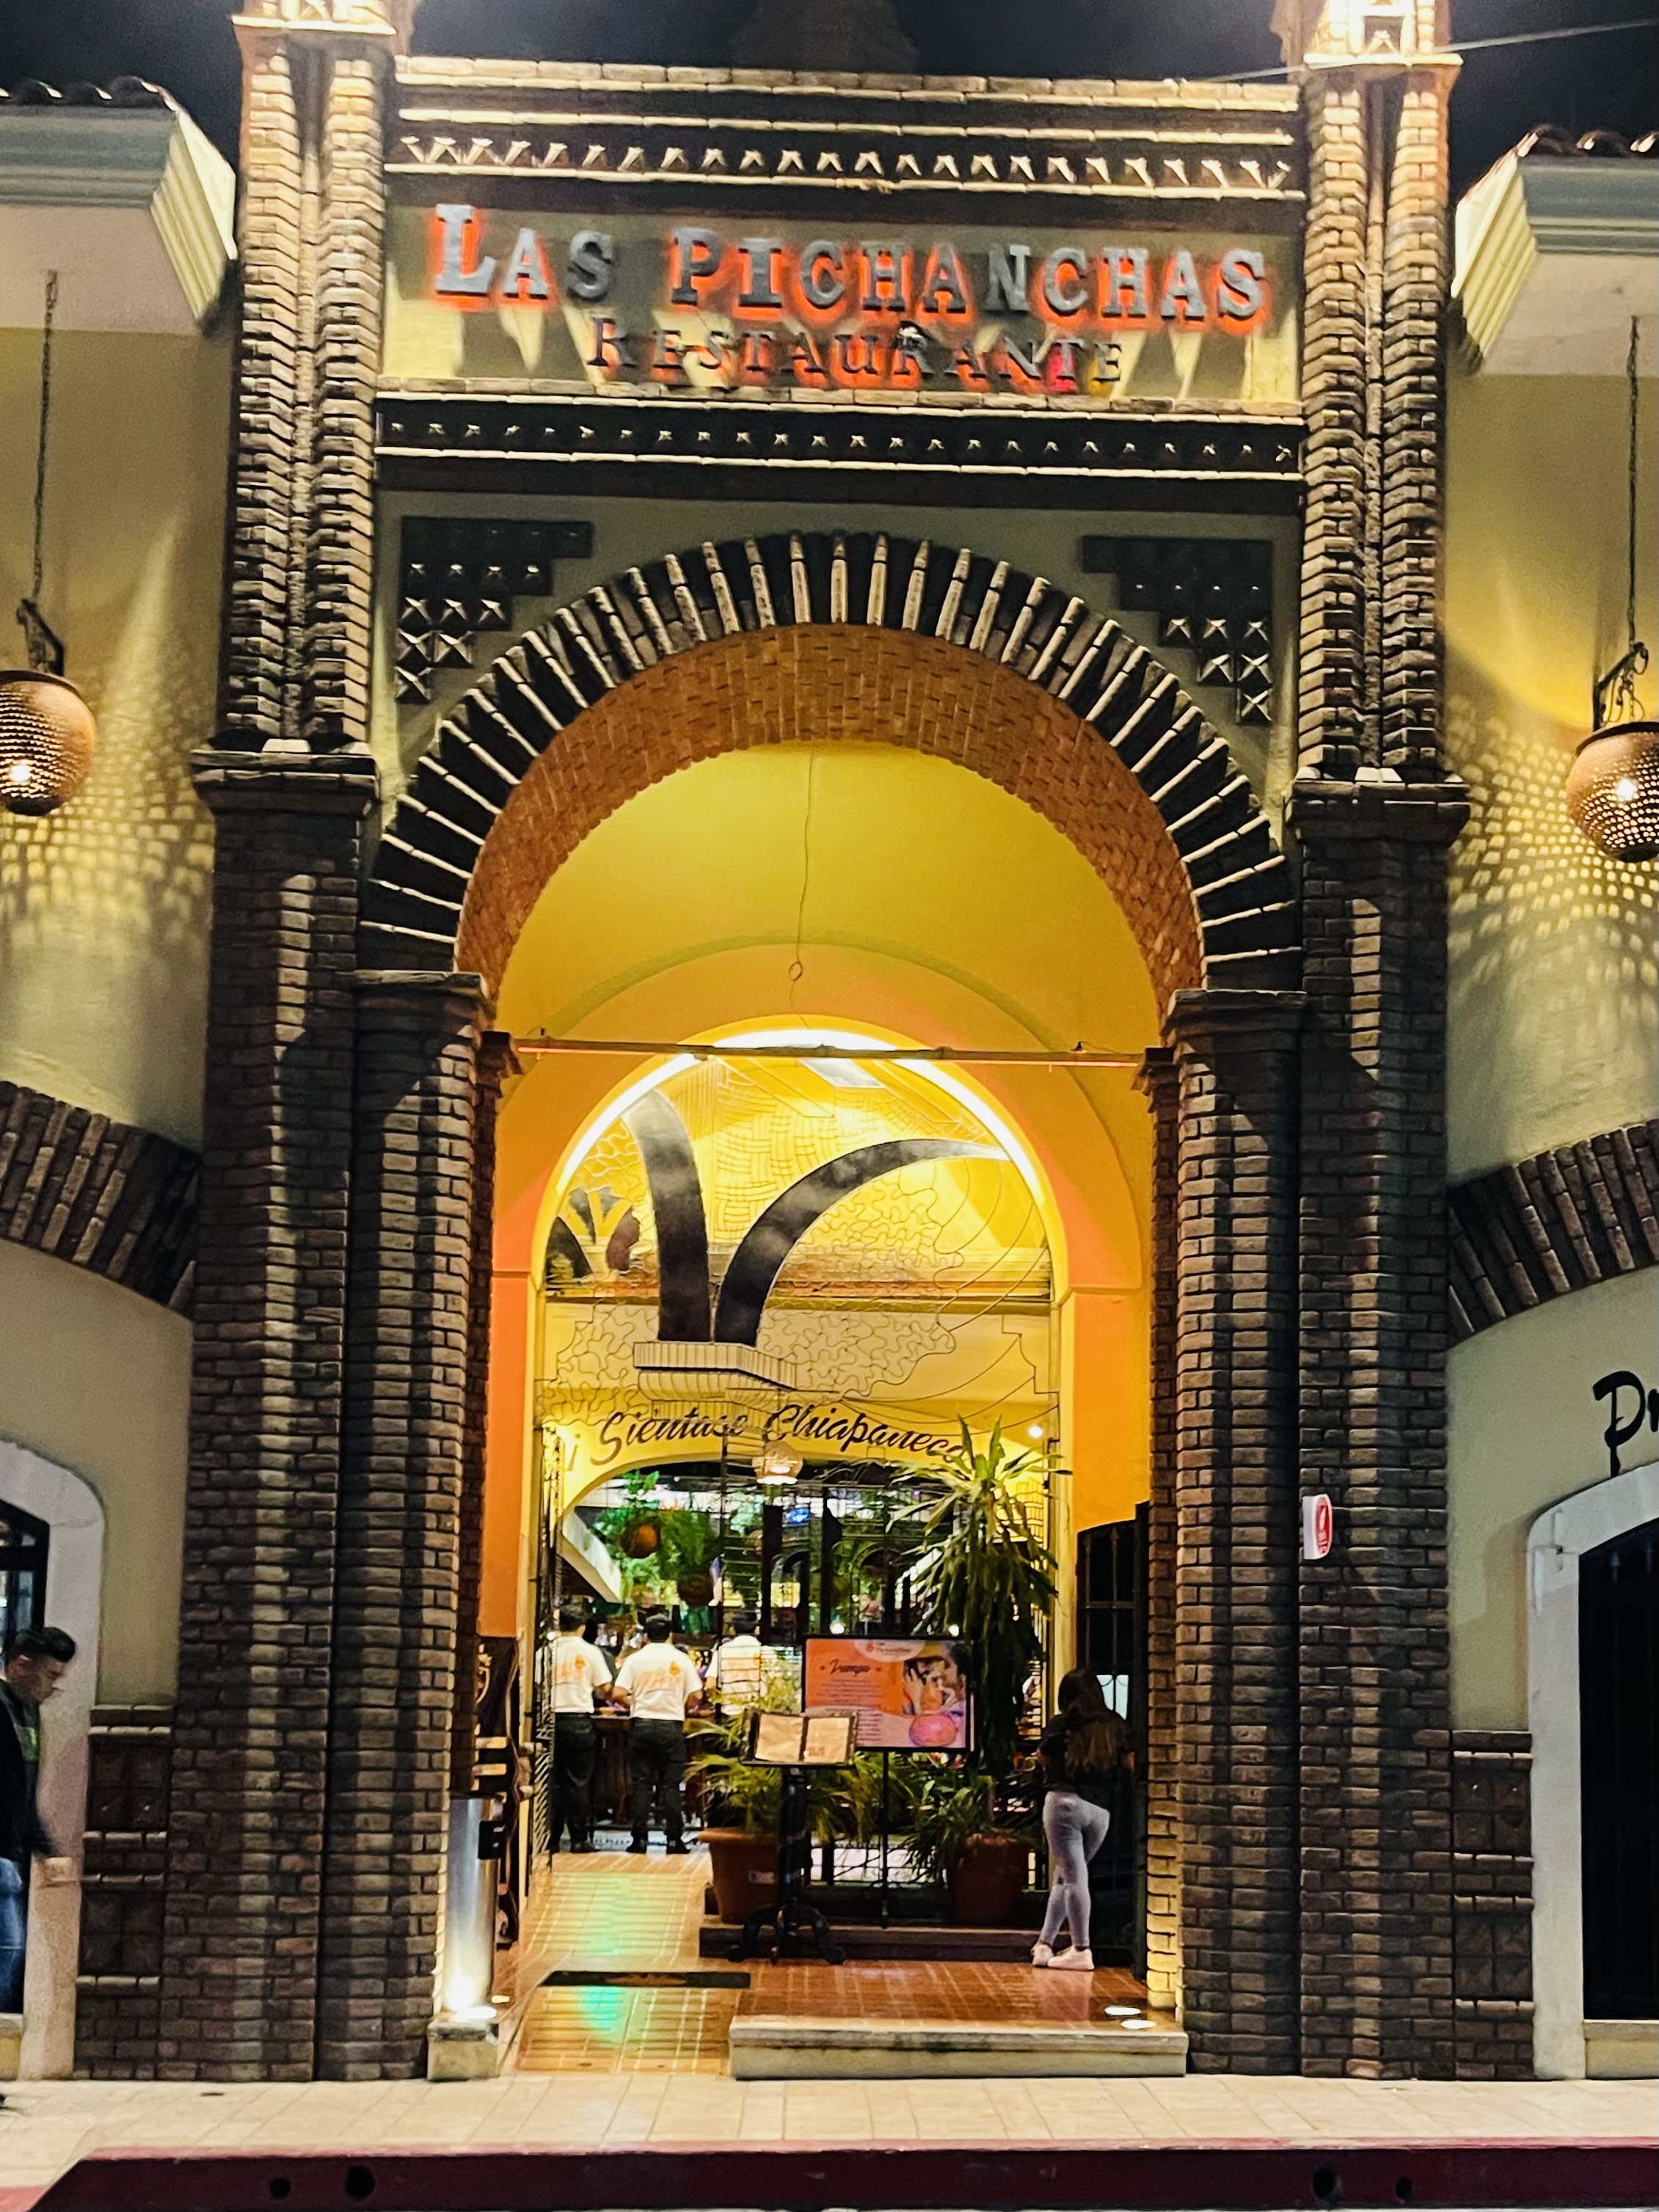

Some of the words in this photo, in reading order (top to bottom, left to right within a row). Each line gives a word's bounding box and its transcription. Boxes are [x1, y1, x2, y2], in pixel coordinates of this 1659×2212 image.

[435, 203, 613, 302] LAS
[671, 227, 1265, 321] PICHANCHAS
[586, 316, 1123, 382] RESTAURANTE
